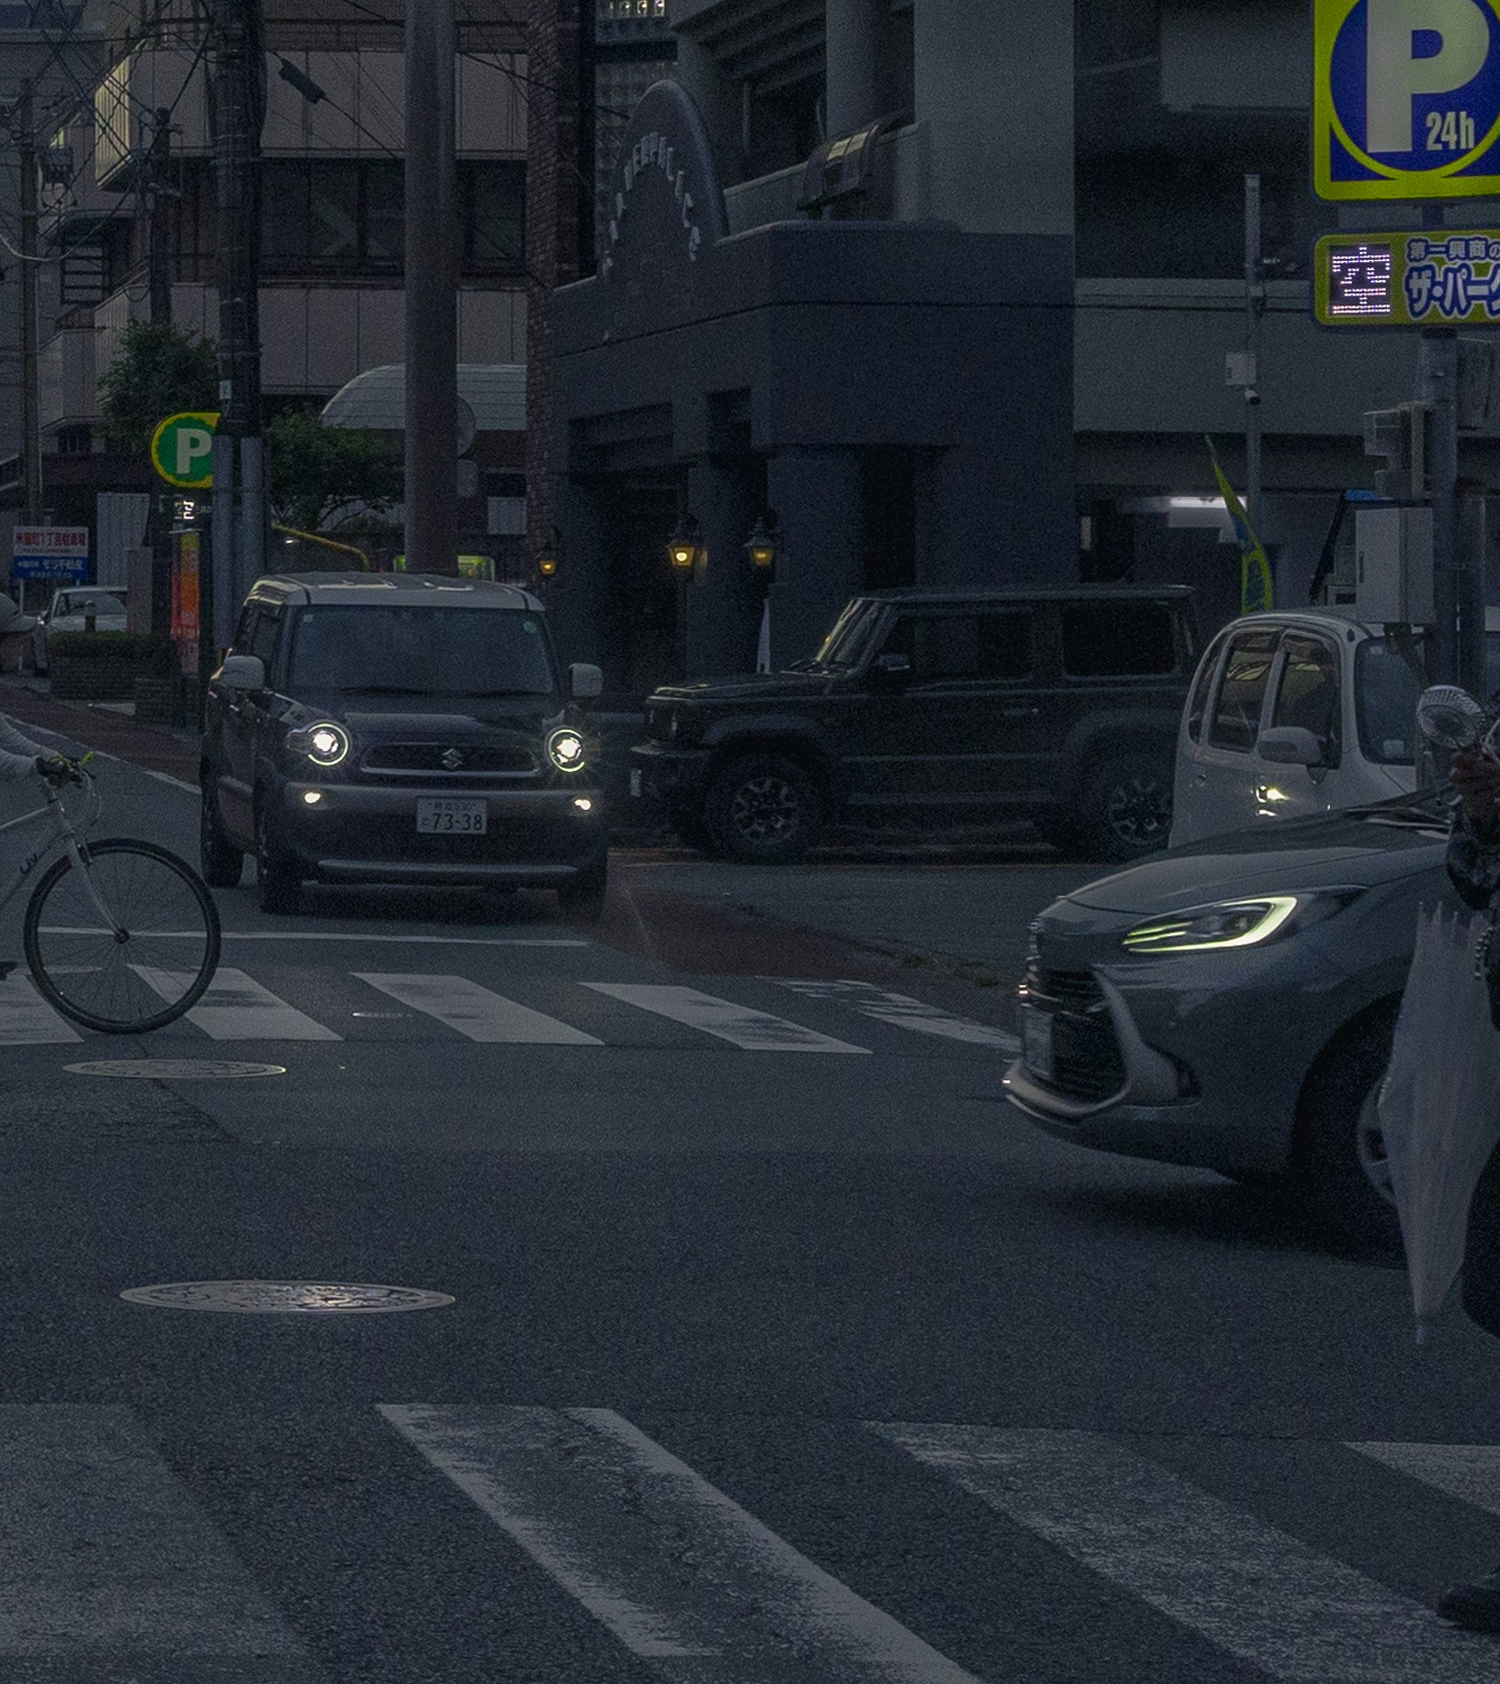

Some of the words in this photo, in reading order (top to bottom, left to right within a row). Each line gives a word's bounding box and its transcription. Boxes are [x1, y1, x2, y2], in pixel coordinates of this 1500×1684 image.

[1426, 112, 1474, 151] 24h
[1332, 246, 1390, 314] 空
[176, 428, 213, 475] P
[432, 812, 483, 830] 73-38
